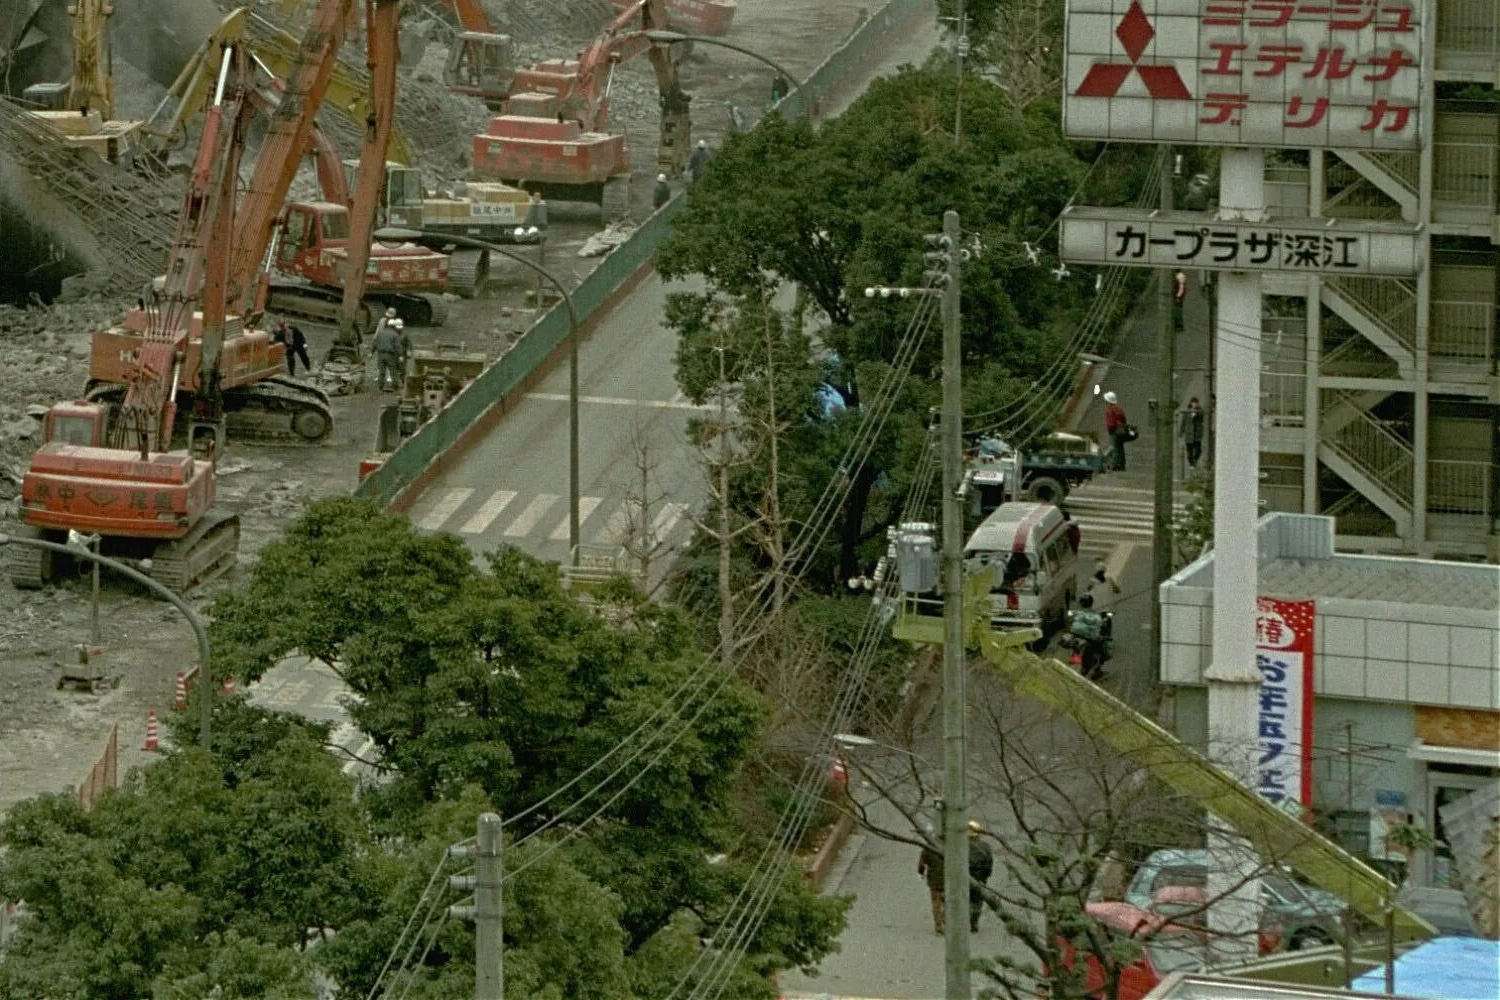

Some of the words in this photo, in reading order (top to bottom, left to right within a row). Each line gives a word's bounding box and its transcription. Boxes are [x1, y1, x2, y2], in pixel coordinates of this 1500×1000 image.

[1201, 44, 1413, 82] エテルナ
[1201, 94, 1415, 131] デリカ
[1116, 226, 1358, 268] カープラザ深江
